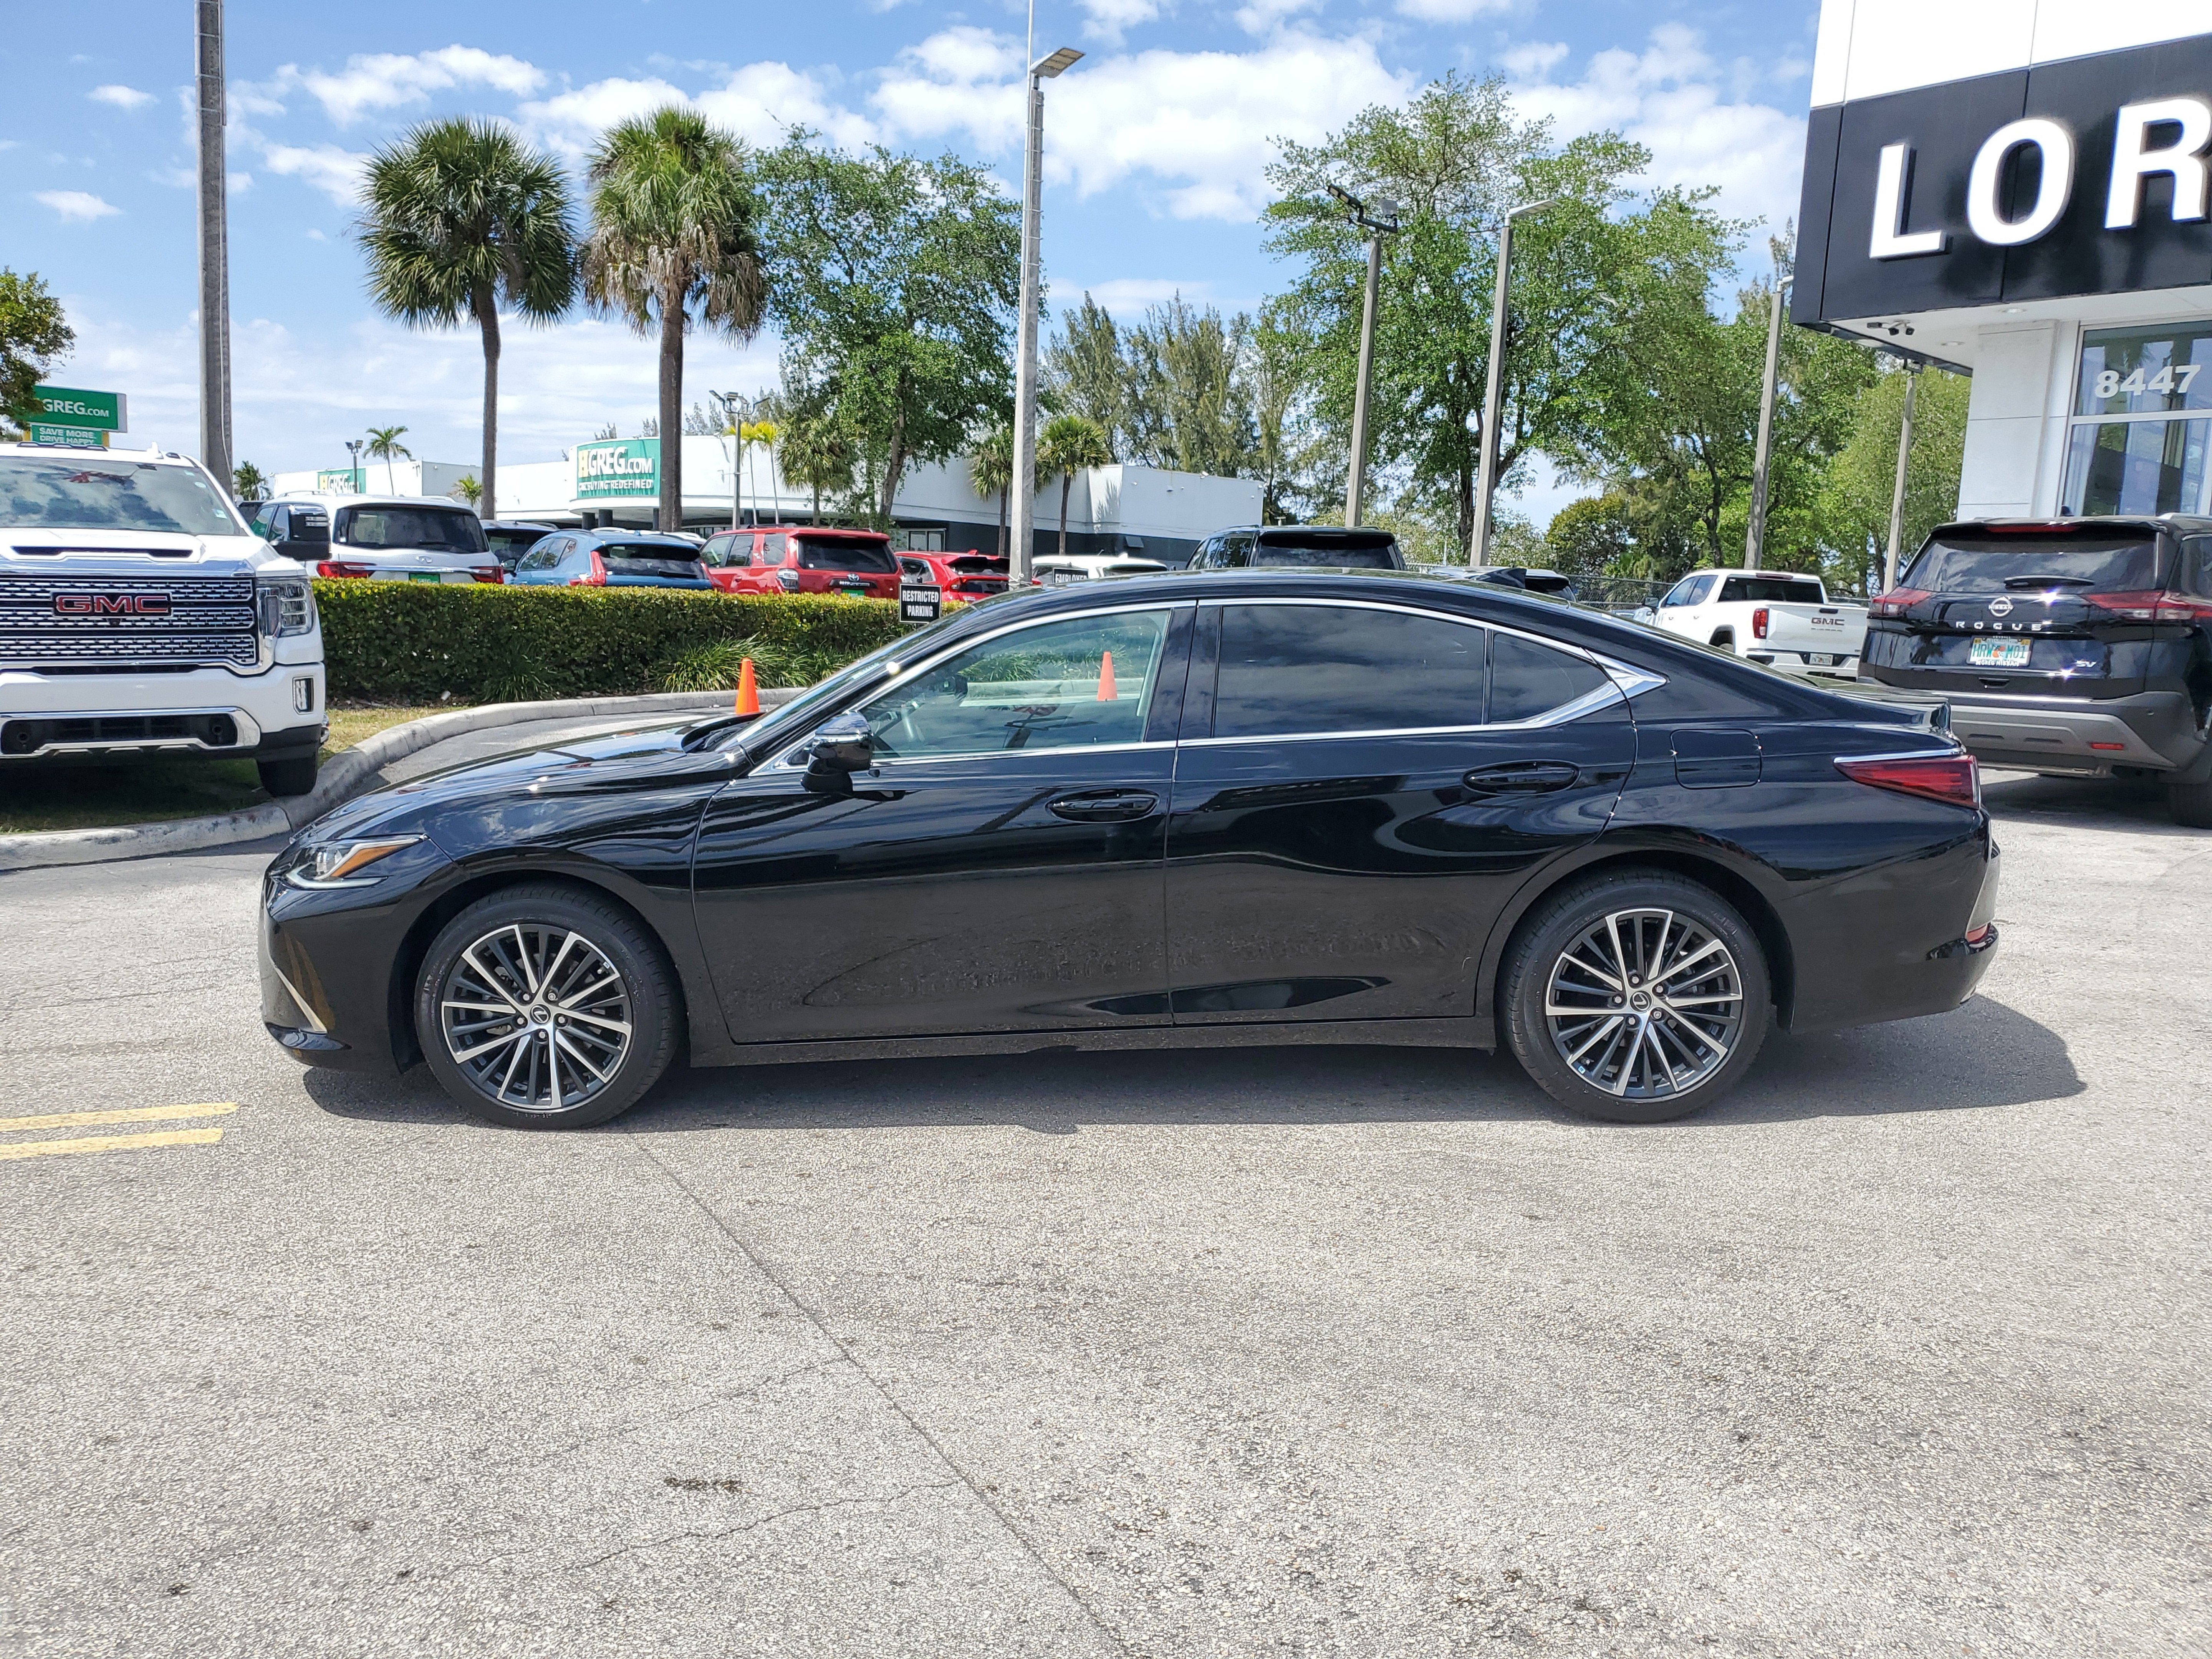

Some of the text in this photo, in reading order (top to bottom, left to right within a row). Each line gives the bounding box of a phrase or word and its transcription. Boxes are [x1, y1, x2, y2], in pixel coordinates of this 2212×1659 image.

[1869, 98, 2211, 258] LOR
[2095, 365, 2201, 398] 8447
[40, 399, 109, 417] GREG.COM
[39, 427, 96, 439] SAVE MORE.
[578, 447, 654, 478] HGREG.COM
[587, 480, 610, 491] BUYING
[611, 479, 653, 489] REDEFINED
[902, 590, 939, 603] RESTRICTED
[56, 596, 168, 613] GMC
[907, 605, 933, 617] PARKING
[1811, 617, 1845, 626] GMC
[1955, 621, 2042, 631] ROGUE
